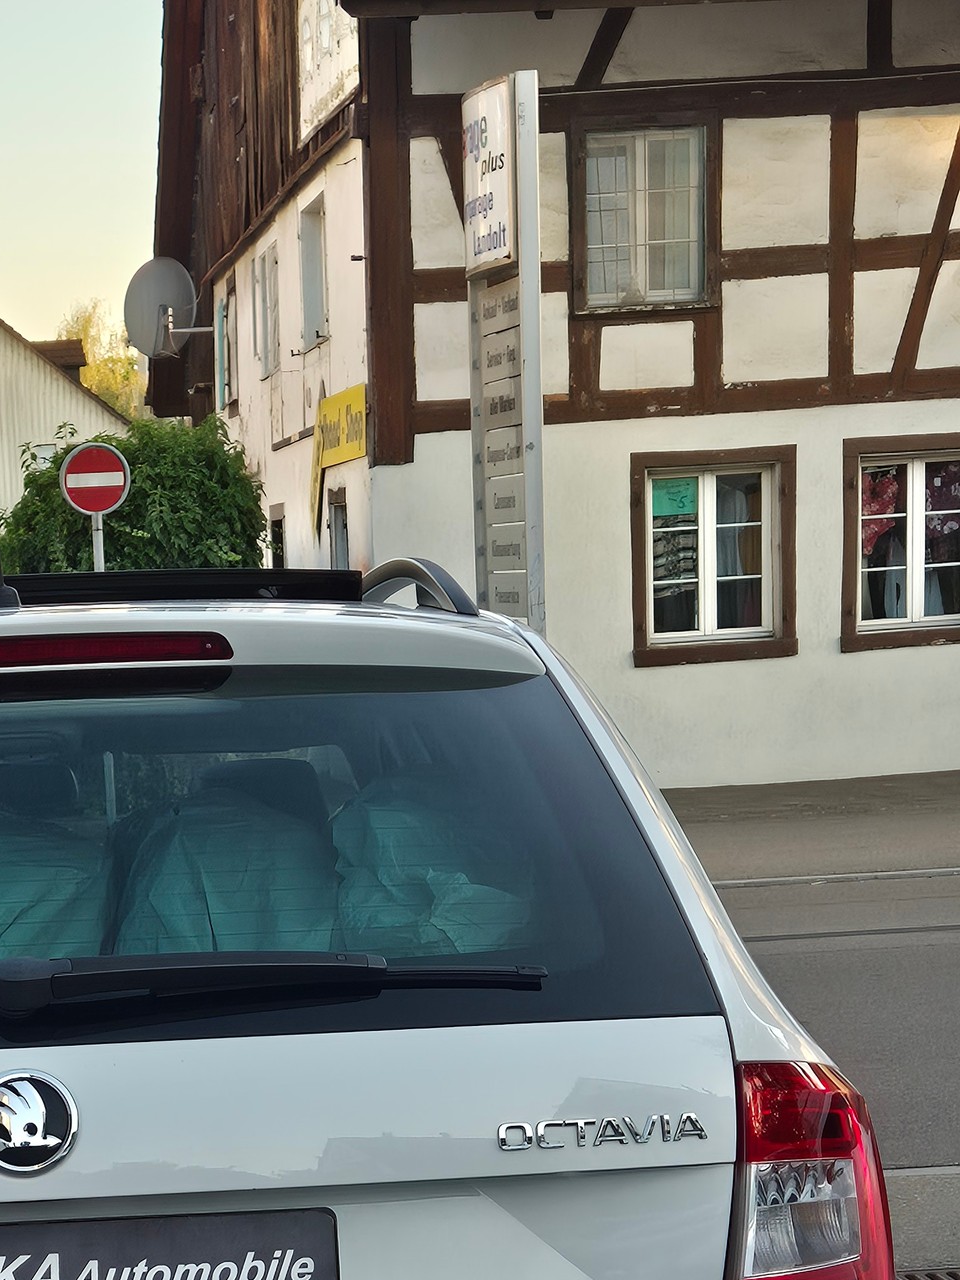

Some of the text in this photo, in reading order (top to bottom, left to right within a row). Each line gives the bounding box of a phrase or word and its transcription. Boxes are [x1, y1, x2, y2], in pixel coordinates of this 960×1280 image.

[481, 150, 505, 182] plus
[473, 221, 507, 256] Landolt
[497, 1111, 708, 1151] OCTAVIA
